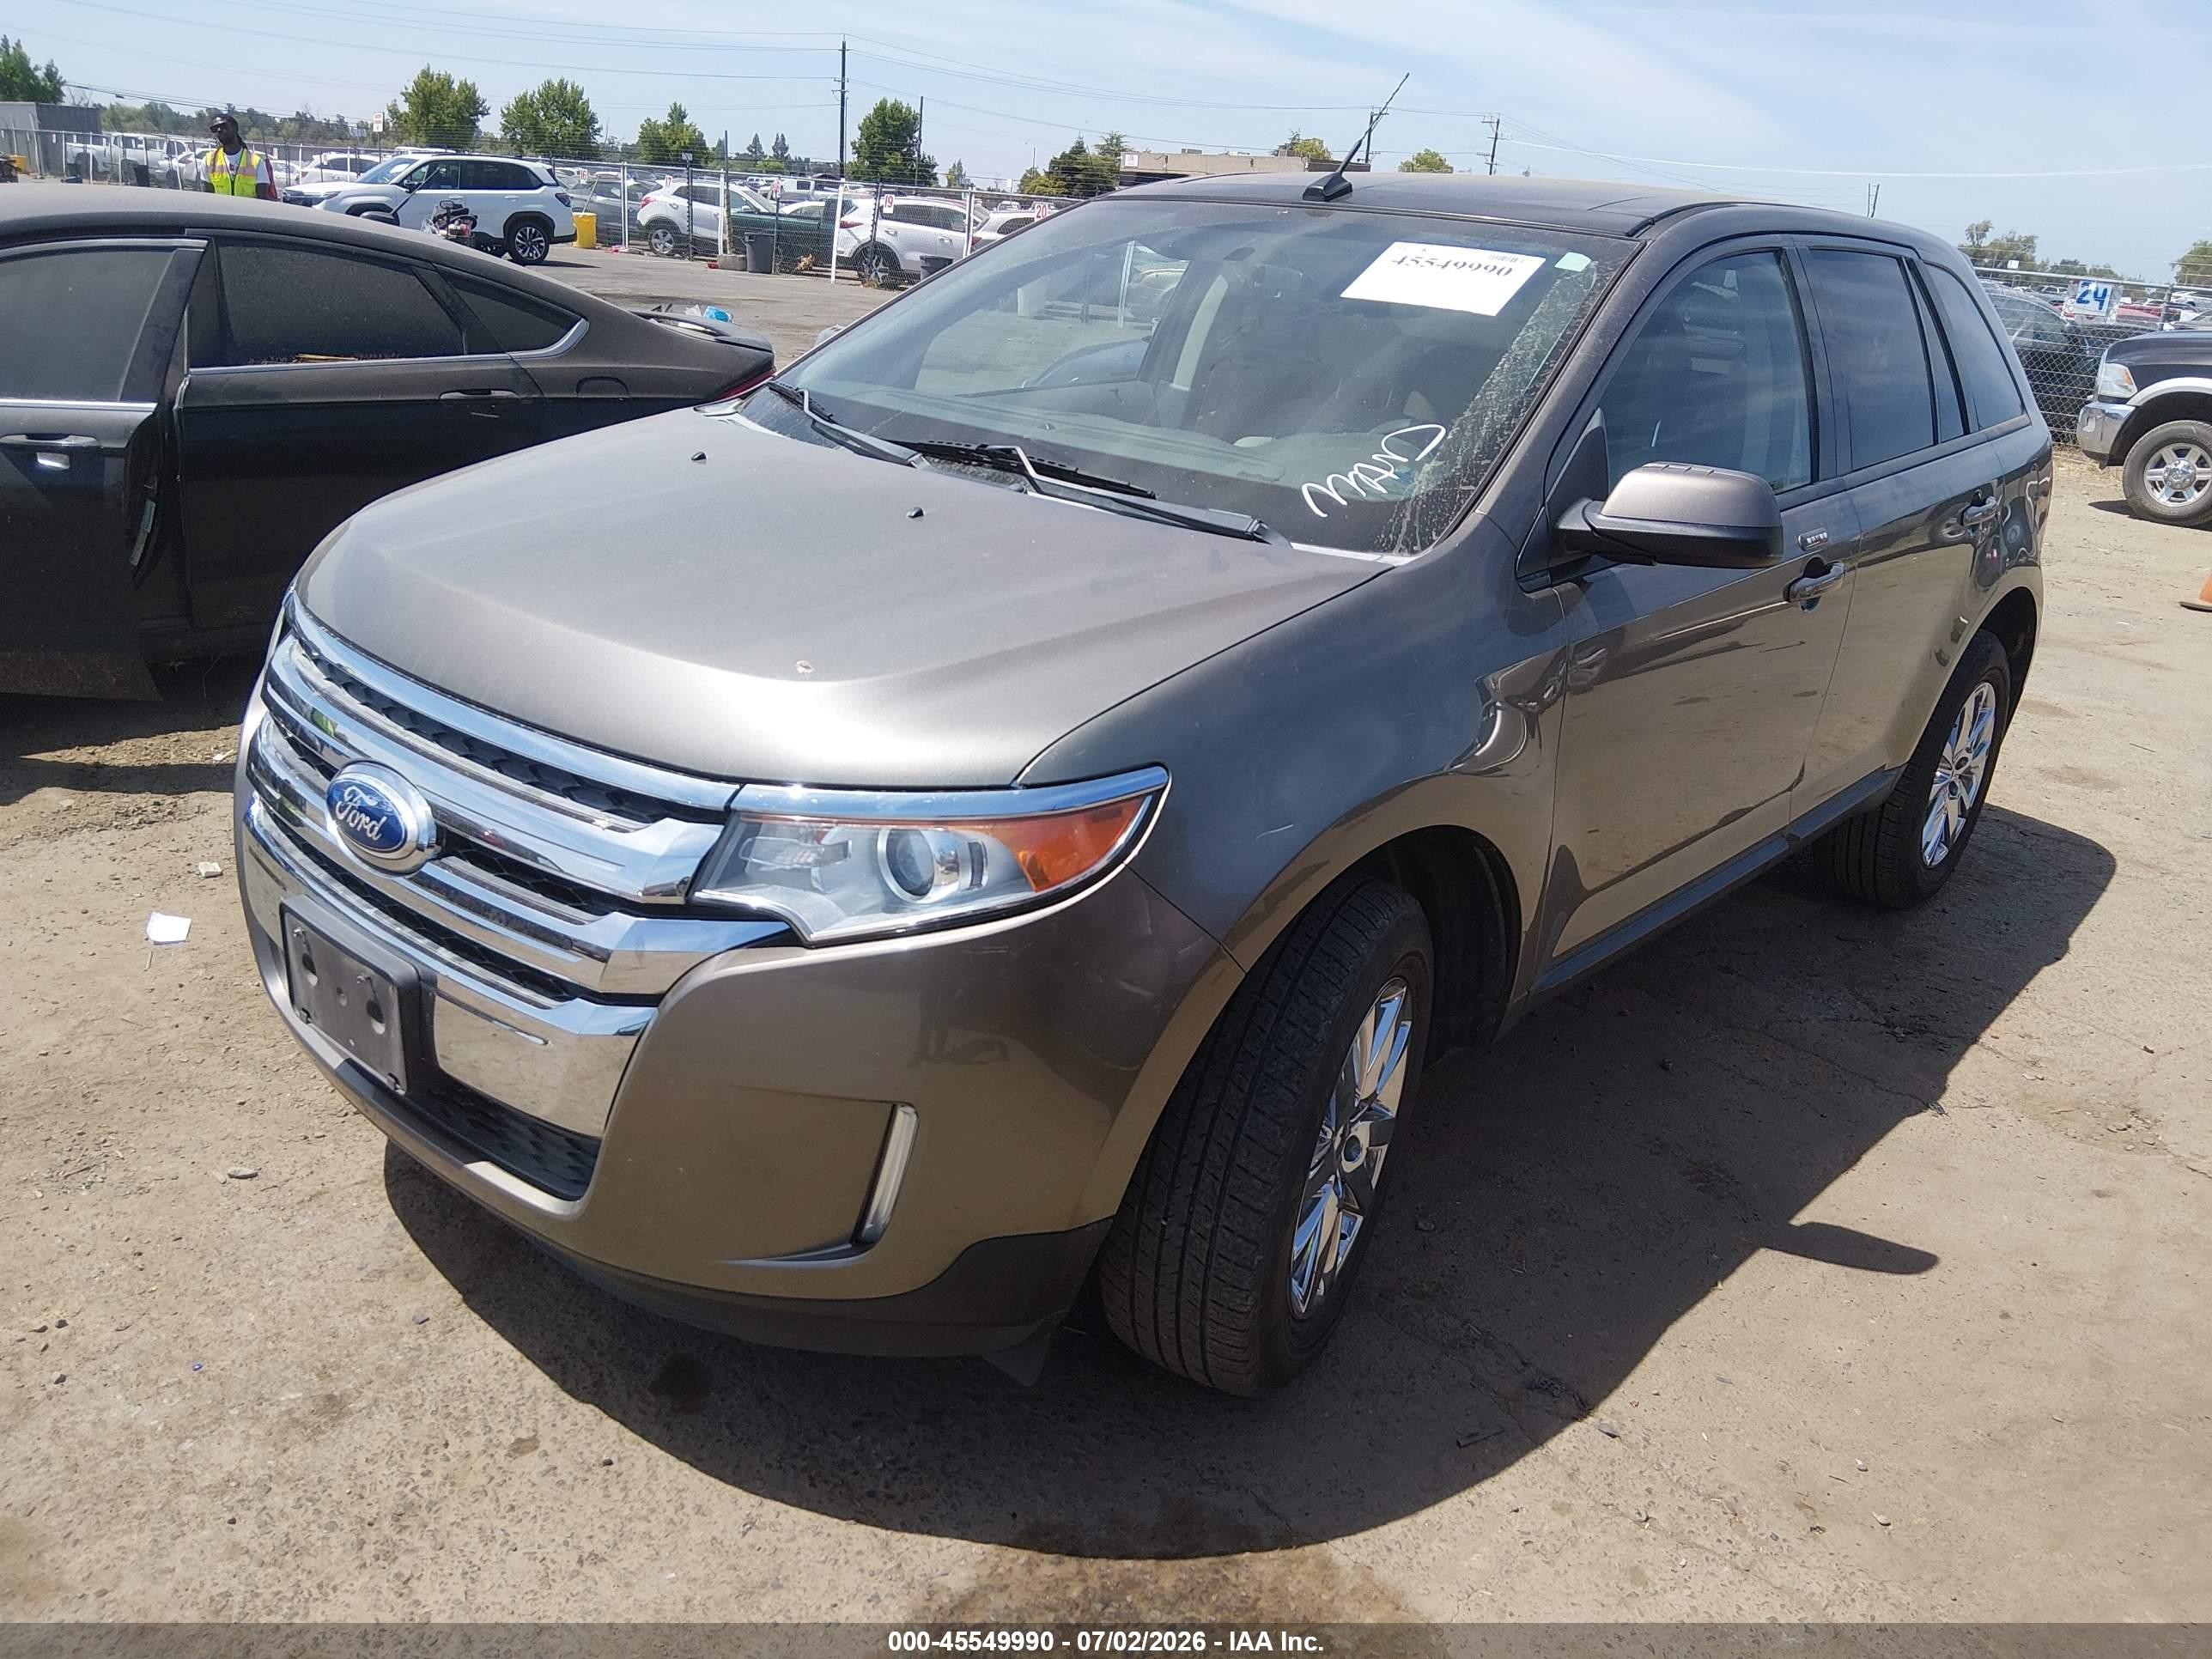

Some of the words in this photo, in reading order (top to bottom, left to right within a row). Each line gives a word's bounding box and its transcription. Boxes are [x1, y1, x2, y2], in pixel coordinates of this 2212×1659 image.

[884, 194, 894, 208] 19
[1036, 204, 1047, 219] 20
[1392, 255, 1514, 276] 45549990
[2075, 280, 2108, 311] 24
[335, 785, 387, 841] Ford
